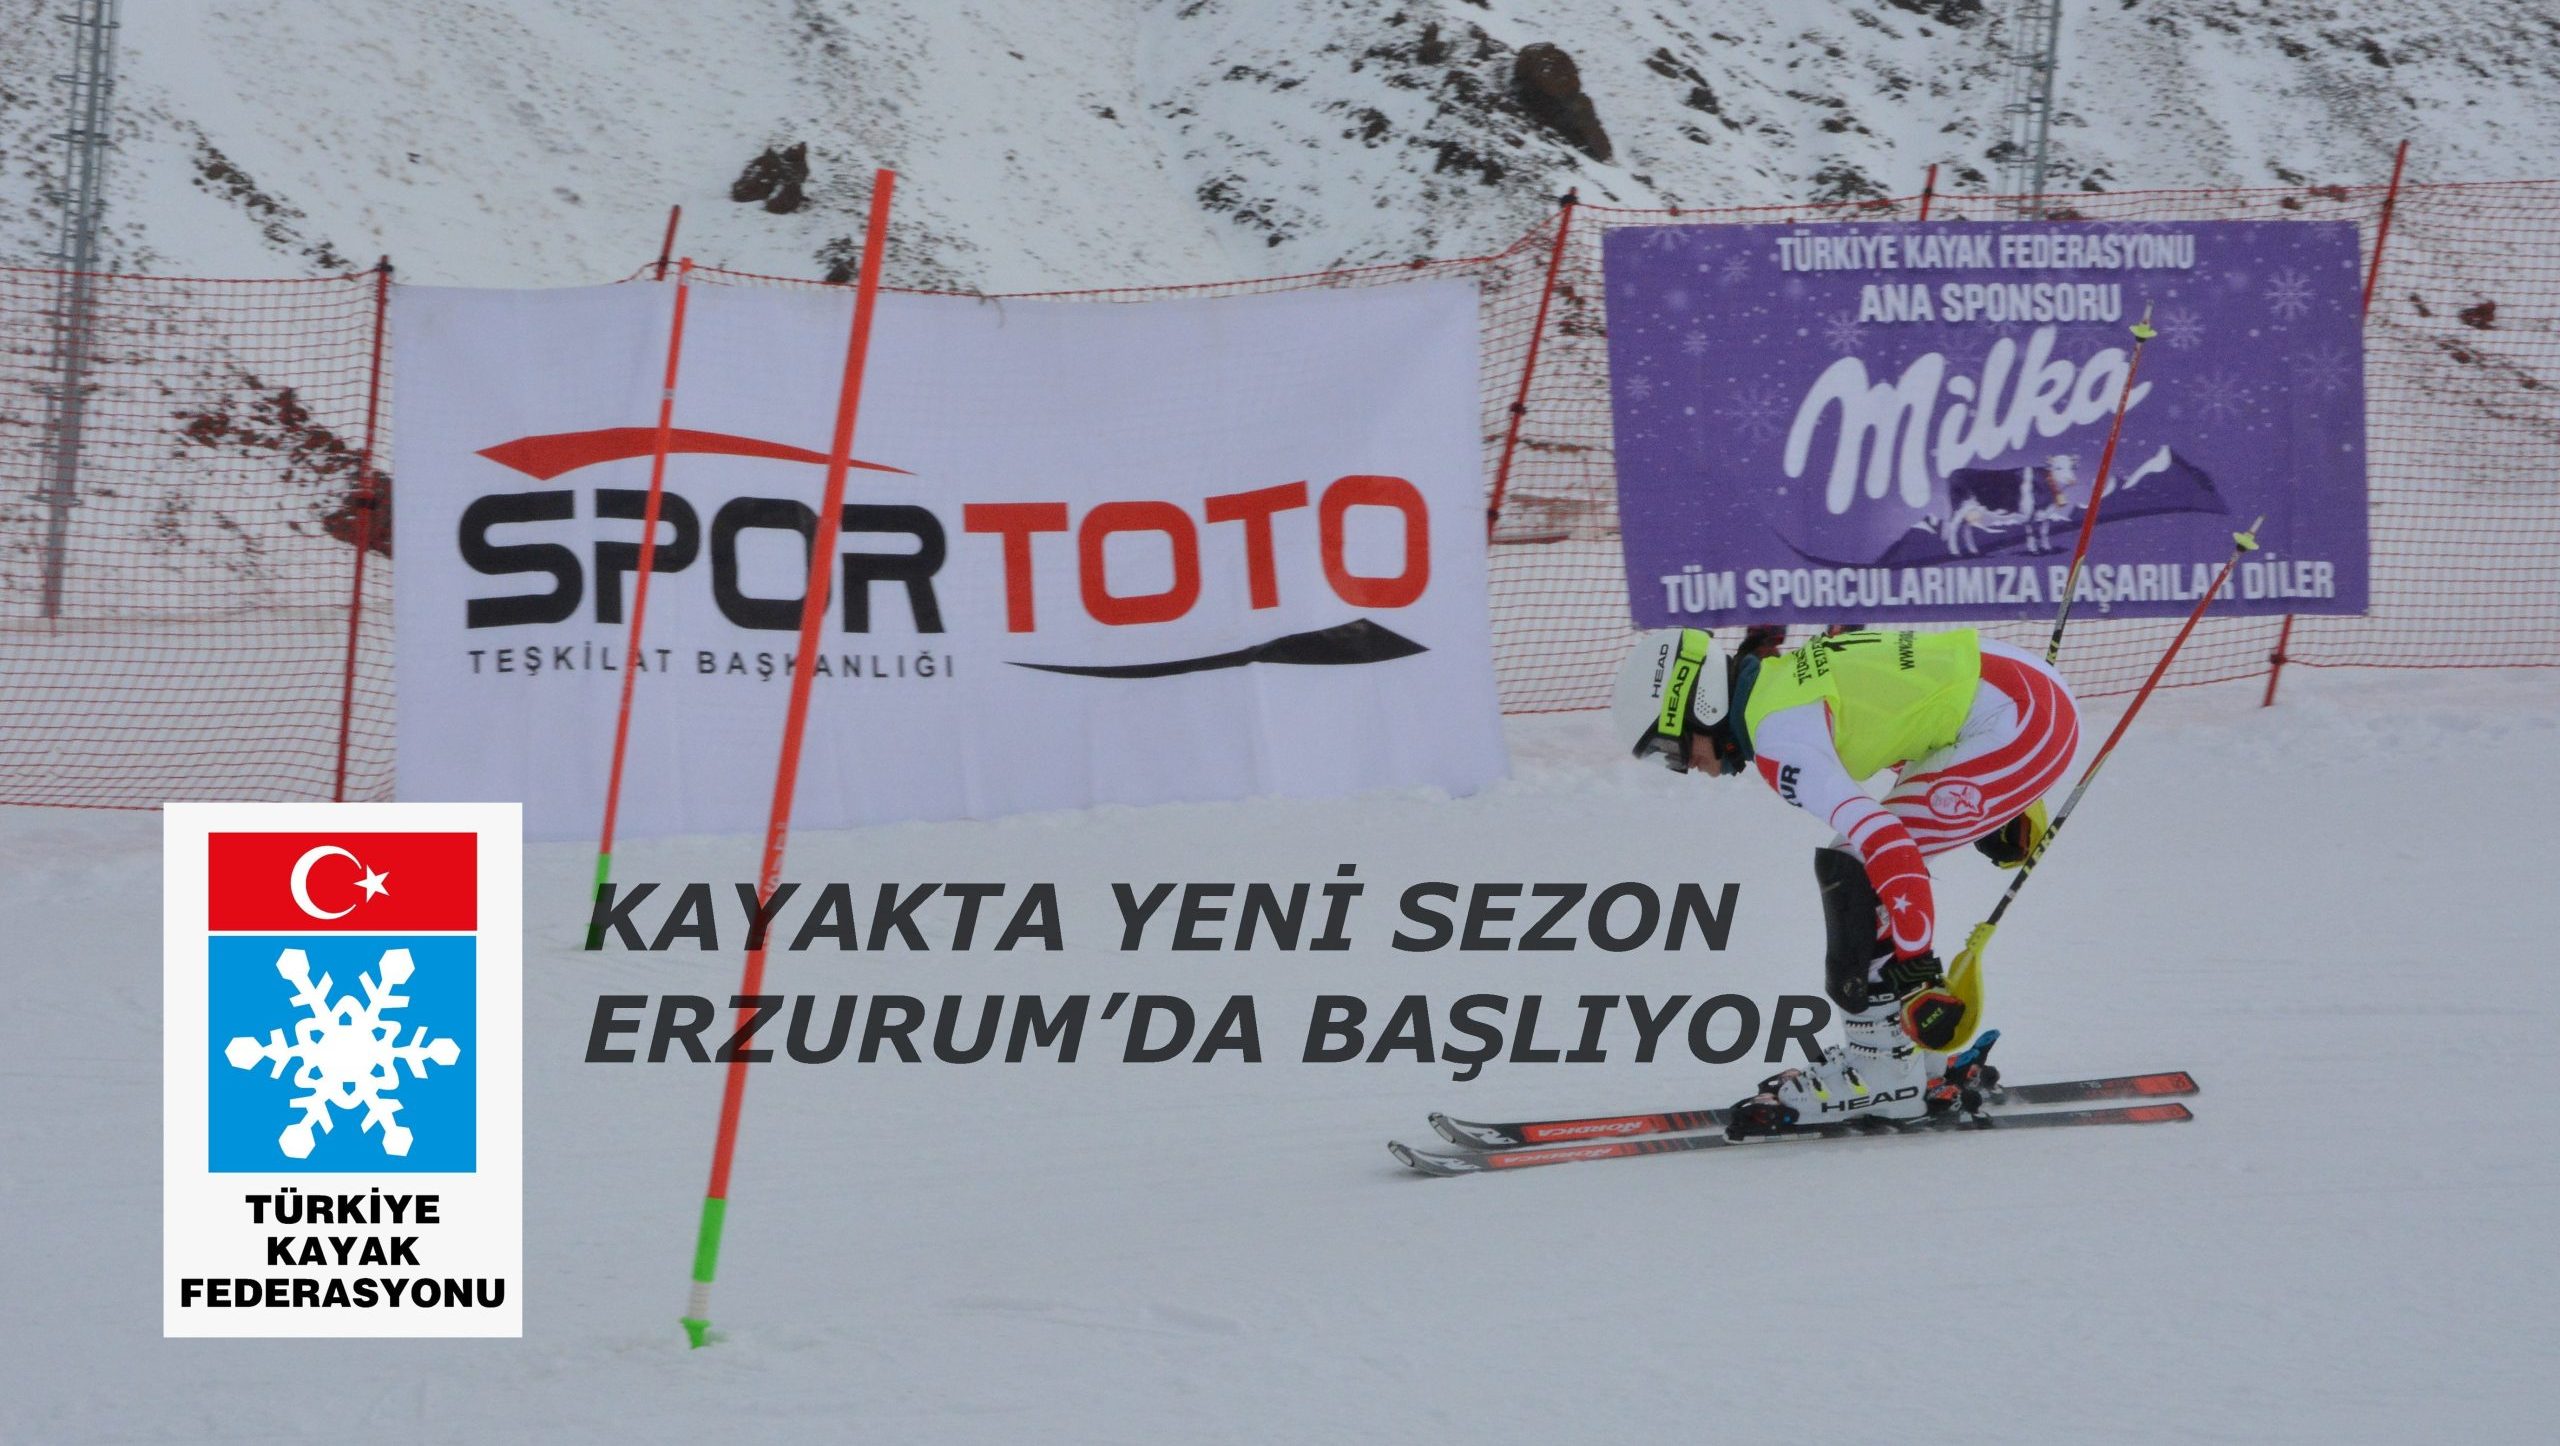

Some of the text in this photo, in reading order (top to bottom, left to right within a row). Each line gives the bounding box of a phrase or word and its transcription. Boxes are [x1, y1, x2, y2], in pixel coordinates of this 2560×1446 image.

[1775, 229, 2195, 272] TÜRKİYE KAYAK FEDERASYONU
[1858, 283, 2122, 323] ANA SPONSORU
[1783, 325, 2152, 515] Milka
[1660, 552, 2335, 613] TÜM SPORCULARIMIZA BAŞARILAR DİLER
[1651, 644, 1669, 698] HEAD
[1665, 665, 1690, 728] HEAD
[1780, 764, 1802, 808] UR
[1821, 1086, 1919, 1113] HEAD
